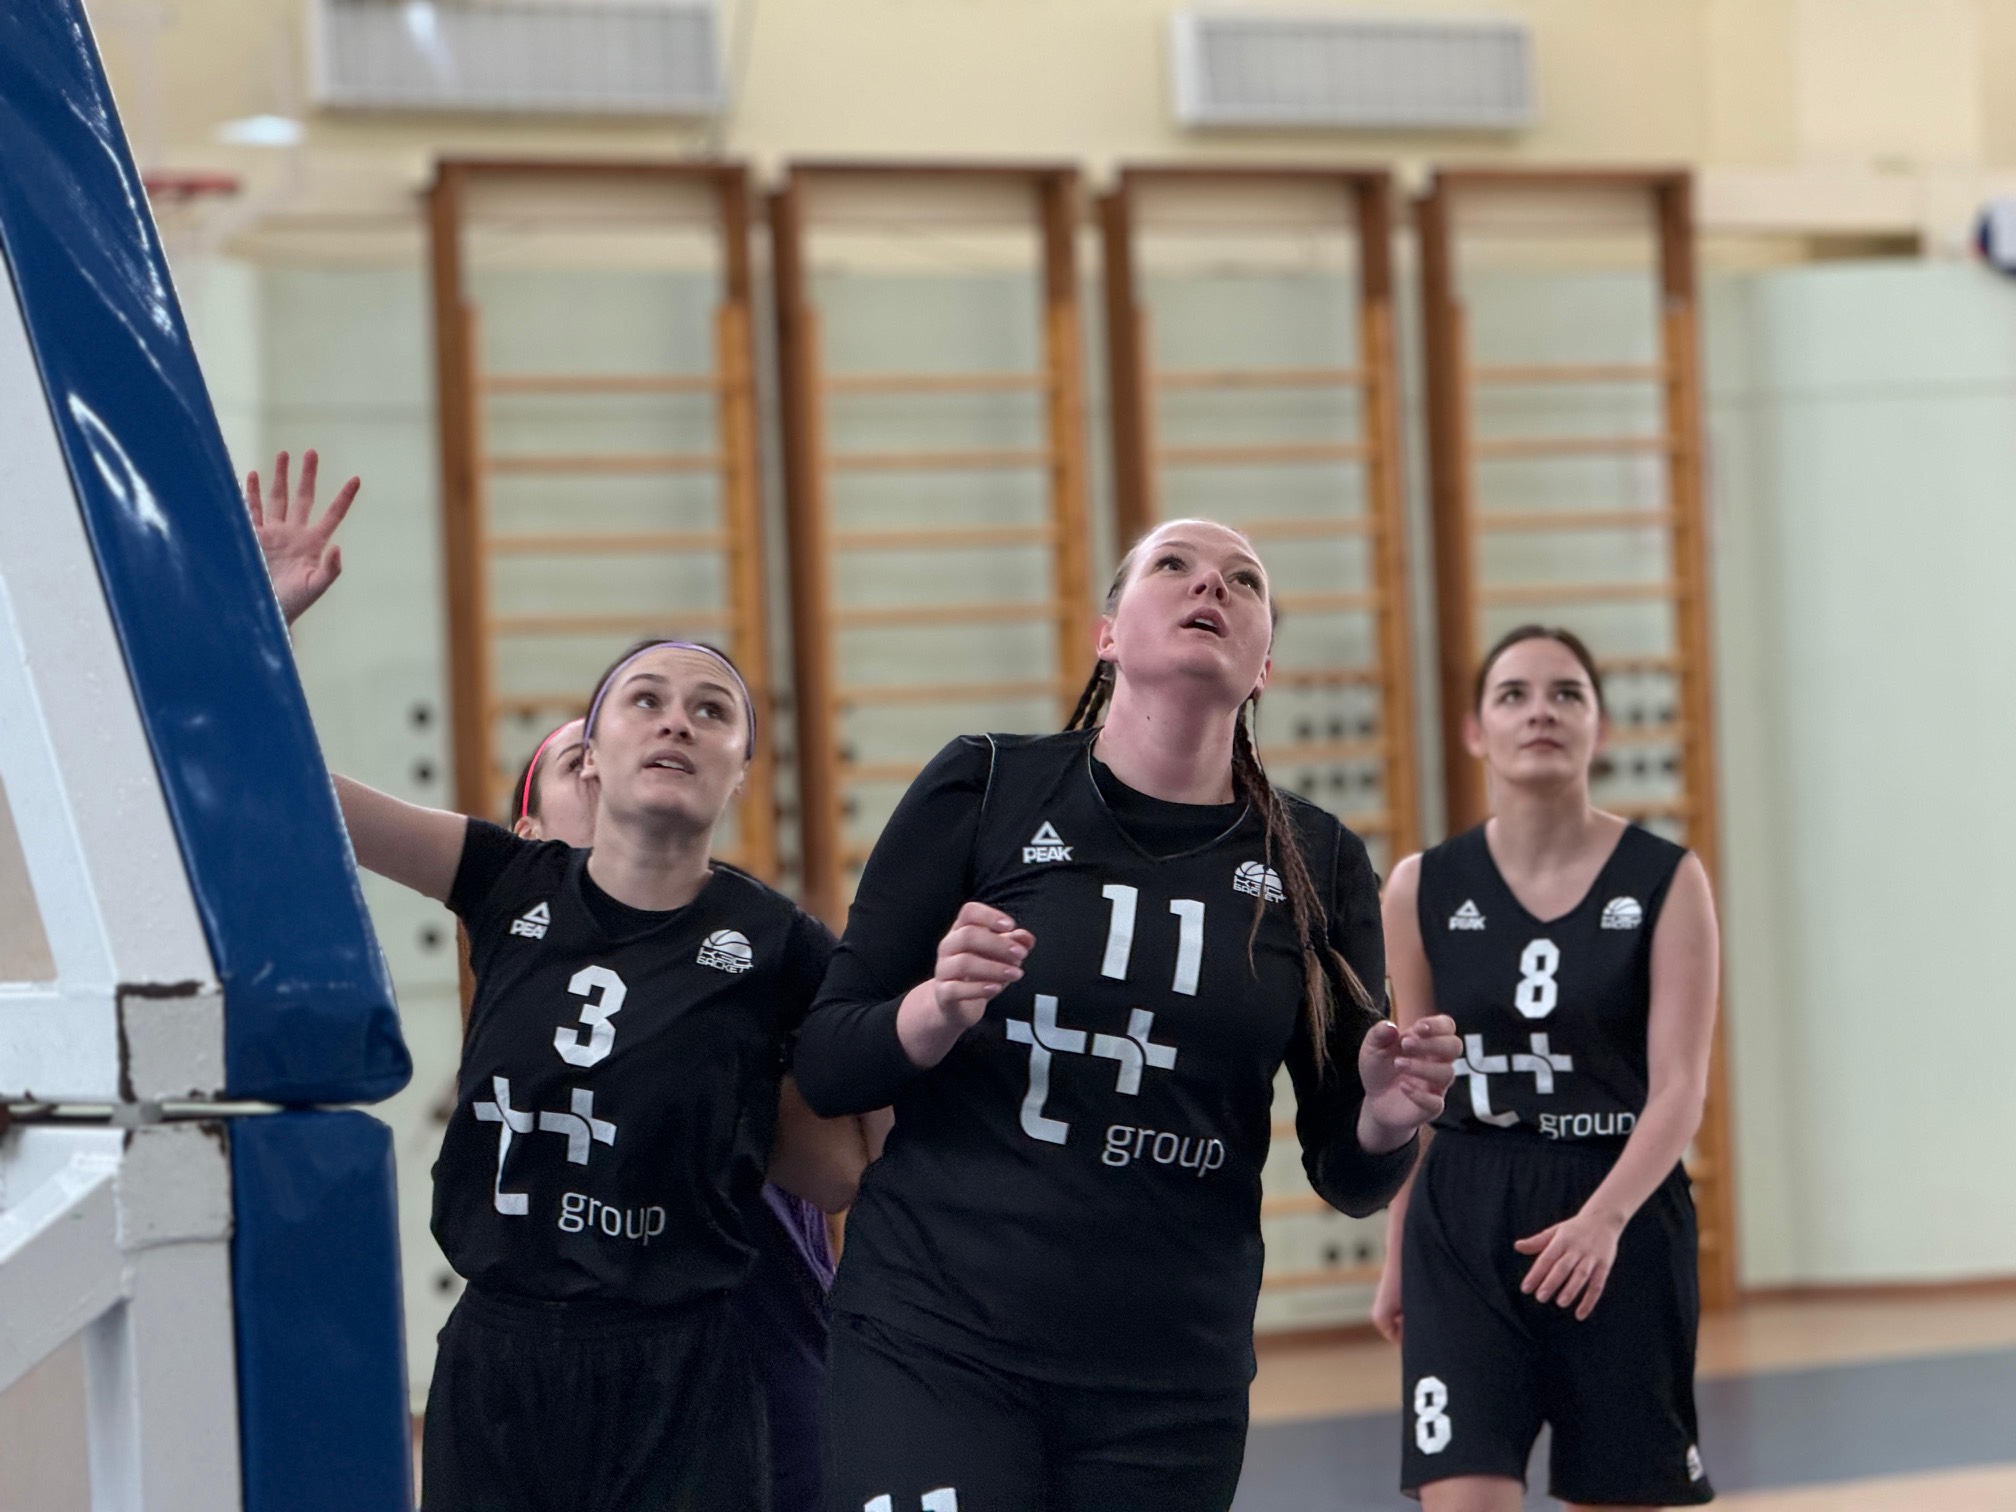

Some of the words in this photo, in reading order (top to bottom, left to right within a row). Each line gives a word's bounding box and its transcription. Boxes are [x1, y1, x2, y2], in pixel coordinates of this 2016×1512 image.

[1022, 846, 1074, 864] PEAK
[1101, 884, 1206, 996] 11
[1514, 938, 1560, 1019] 8
[553, 965, 628, 1068] 3
[1101, 1124, 1225, 1178] group
[557, 1191, 666, 1246] group
[1413, 1375, 1452, 1456] 8
